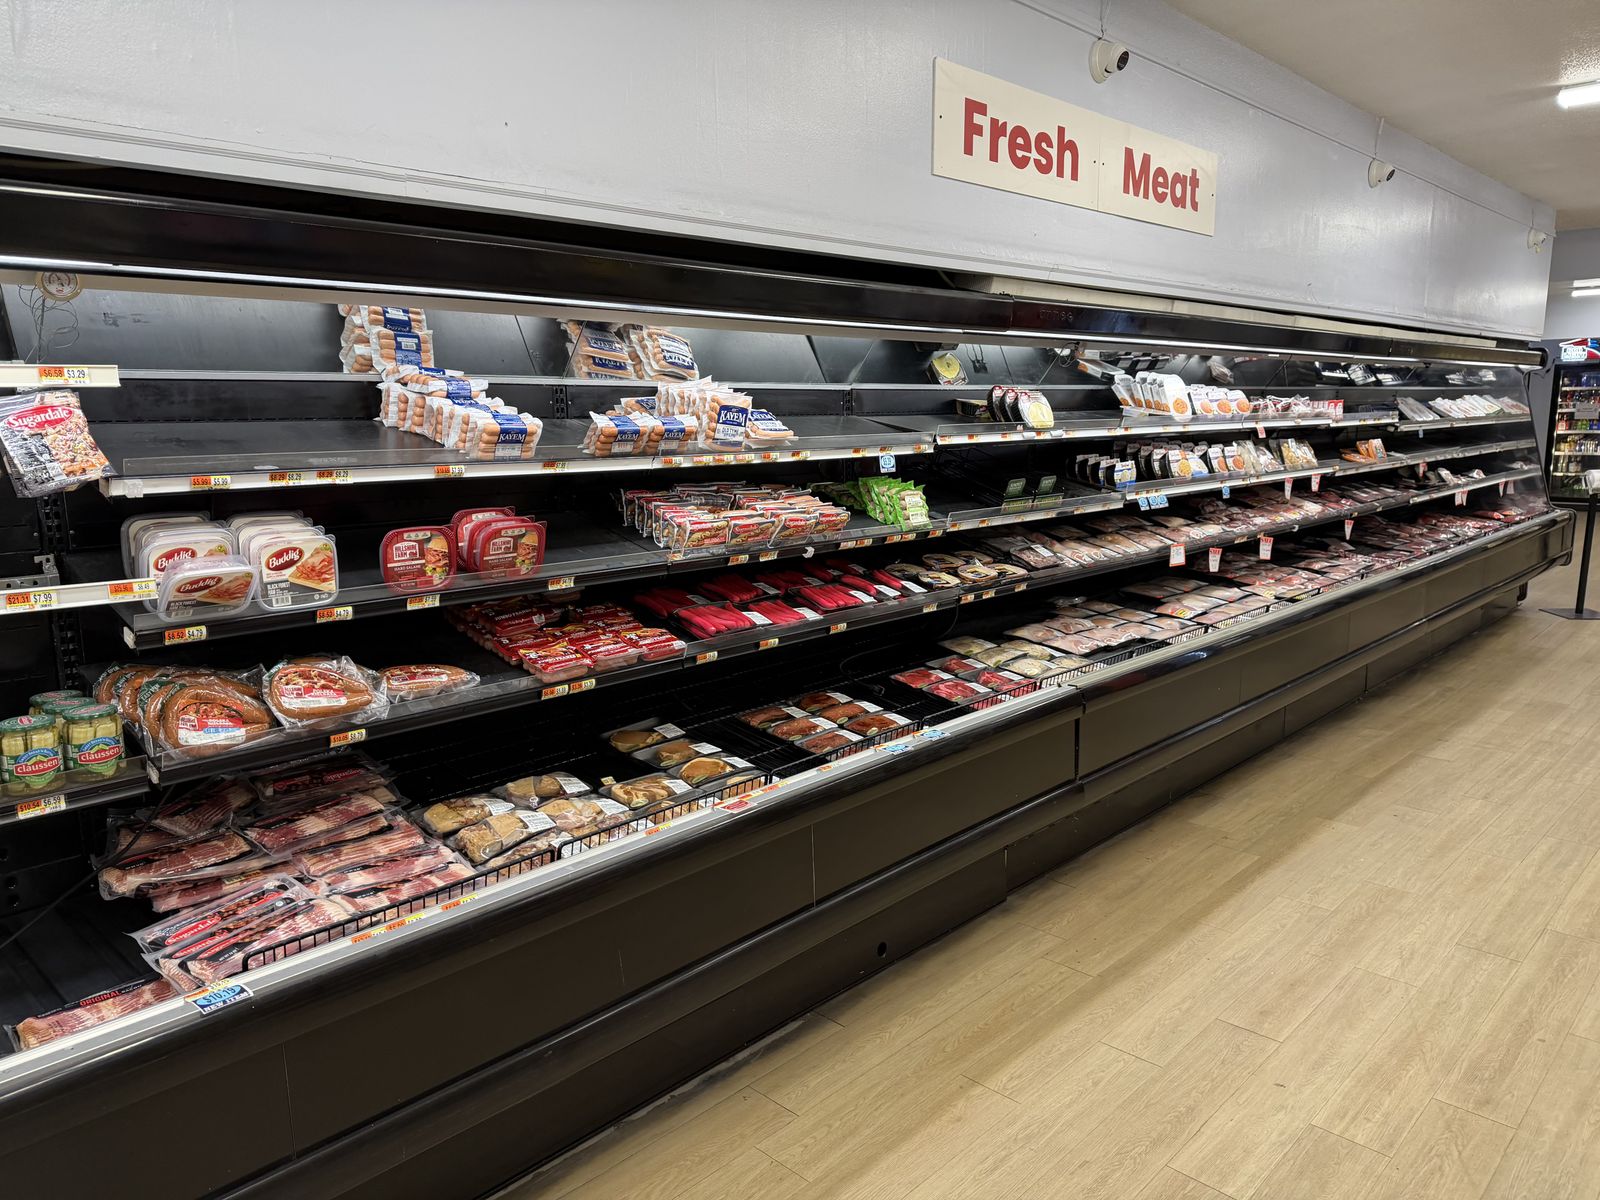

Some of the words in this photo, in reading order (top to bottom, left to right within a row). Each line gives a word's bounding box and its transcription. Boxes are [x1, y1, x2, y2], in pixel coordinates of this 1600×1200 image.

[963, 97, 1079, 181] Fresh
[1122, 146, 1200, 212] Meat
[43, 369, 63, 378] $6.58
[67, 369, 86, 379] $3.29
[9, 406, 71, 428] Sugardale
[718, 410, 746, 426] KAYEM
[498, 433, 525, 441] KAYEM
[616, 433, 639, 442] KAYEM
[663, 432, 685, 441] KAYEM
[192, 477, 208, 486] $5.99
[213, 477, 228, 486] $5.99
[287, 472, 302, 481] $8.29
[335, 470, 349, 478] $8.29
[157, 549, 193, 569] Buddig
[268, 549, 301, 569] Buddig
[180, 577, 219, 592] Buddig
[8, 596, 30, 605] $21.31
[33, 593, 53, 603] $7.99
[335, 609, 350, 617] $4.79
[187, 629, 203, 638] $4.79
[80, 746, 120, 761] claussen
[16, 758, 58, 773] claussen
[43, 795, 61, 807] $6.59
[167, 916, 222, 945] Sugardale
[80, 990, 121, 1006] ORIGINAL
[204, 1001, 224, 1013] NEW
[226, 991, 249, 1005] ITEM
[206, 986, 236, 1004] $10.19
